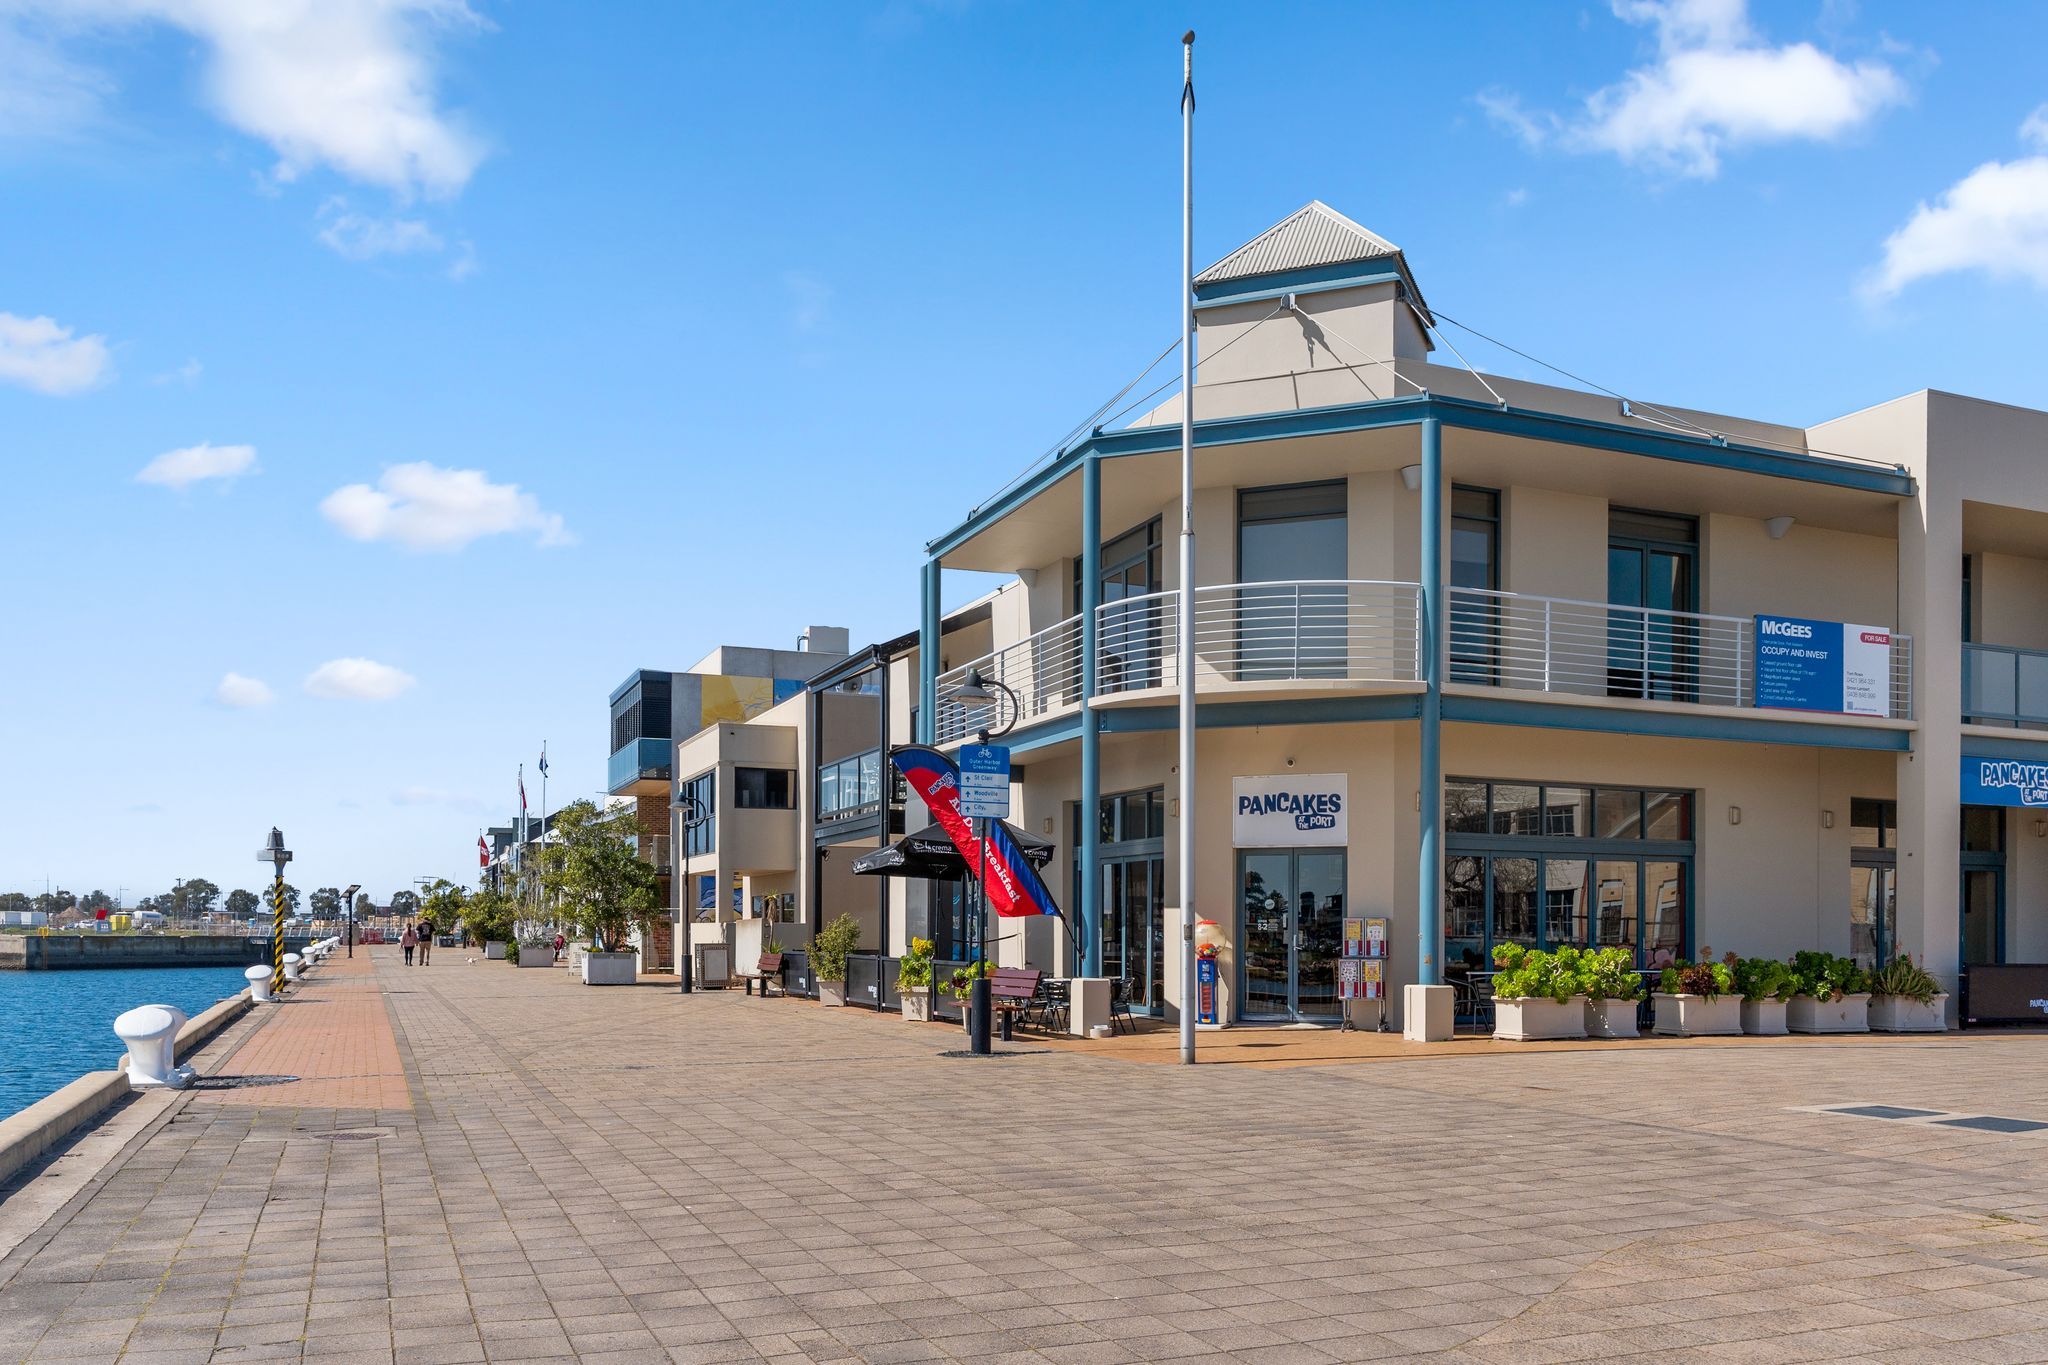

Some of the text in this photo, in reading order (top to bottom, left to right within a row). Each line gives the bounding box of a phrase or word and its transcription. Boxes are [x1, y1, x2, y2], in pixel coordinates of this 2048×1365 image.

[1761, 646, 1828, 659] OCCUPY AND INVEST
[1238, 792, 1341, 815] PANCAKES
[1310, 816, 1333, 827] PORT
